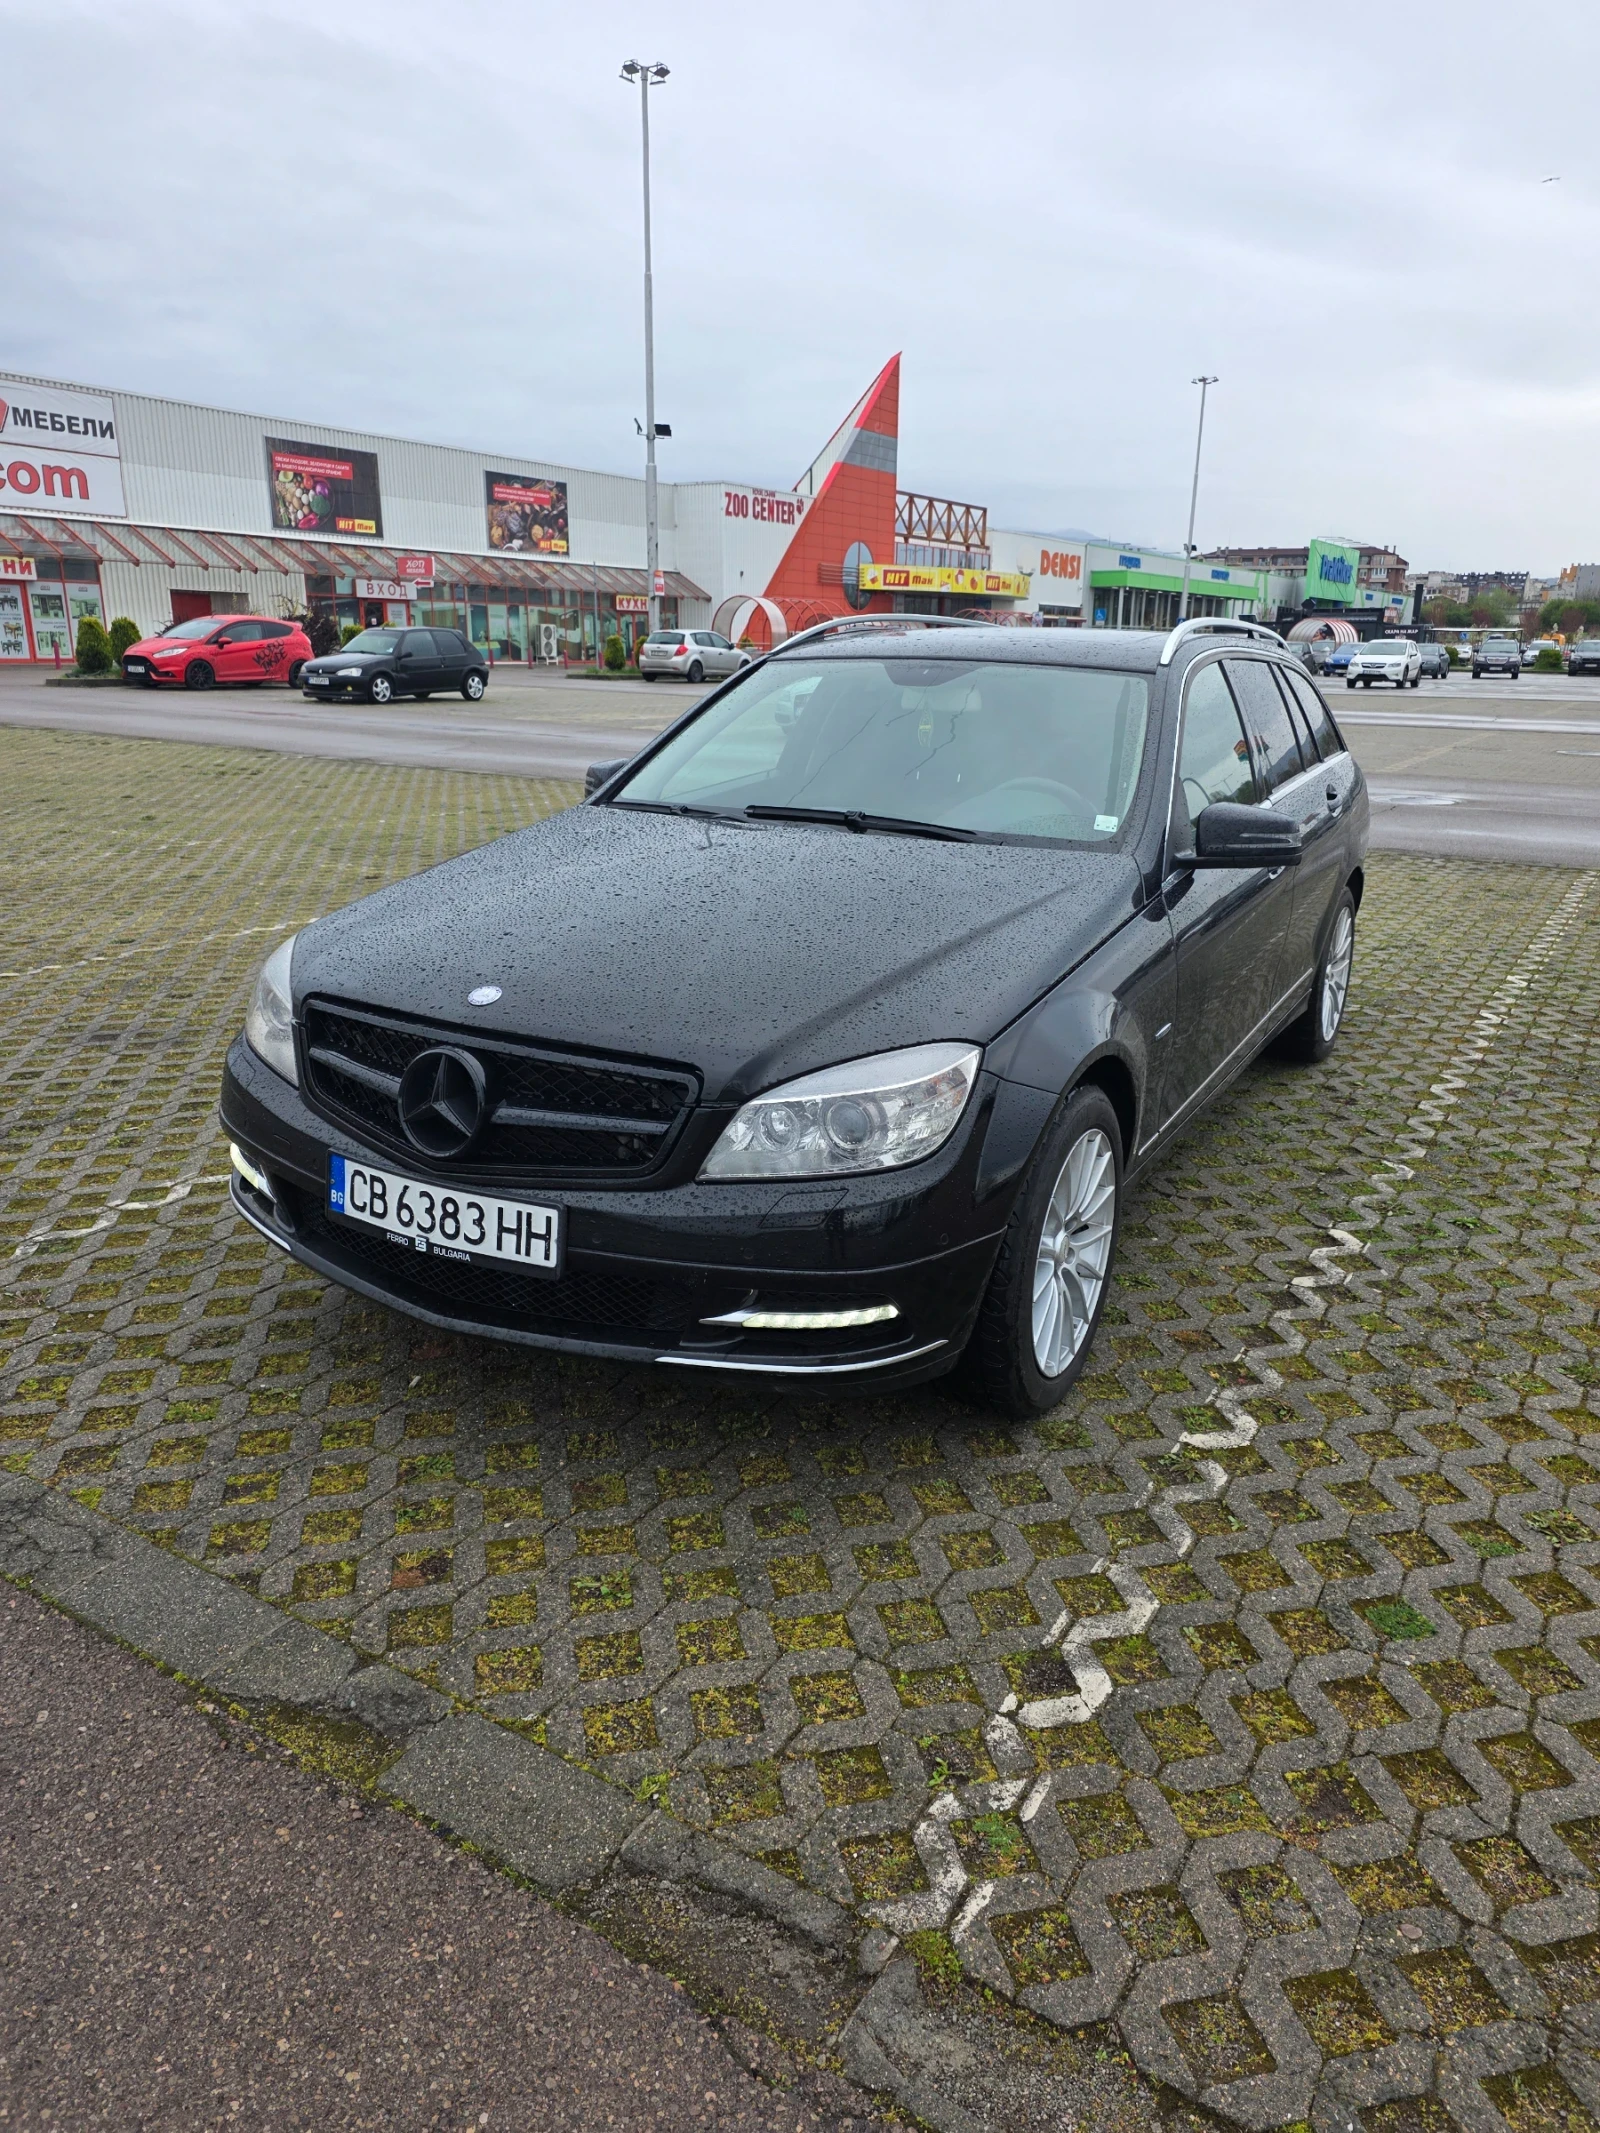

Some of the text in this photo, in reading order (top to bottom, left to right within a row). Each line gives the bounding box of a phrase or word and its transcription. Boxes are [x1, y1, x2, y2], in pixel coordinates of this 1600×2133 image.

[12, 406, 115, 440] МЕБЕЛИ
[0, 460, 90, 500] om
[725, 491, 795, 525] ZOO CENTER
[338, 520, 355, 530] HIT
[540, 540, 551, 549] HIT
[0, 559, 33, 576] НИ
[1040, 549, 1082, 581] DENSI
[1320, 554, 1354, 585] Praktiker
[366, 582, 408, 599] ВХОД
[886, 573, 933, 586] HIT Max
[987, 577, 999, 589] HIT
[618, 596, 648, 610] КУХН
[330, 1169, 553, 1262] BG CB 6383 HH
[386, 1232, 471, 1263] FERRO BULGARIA
